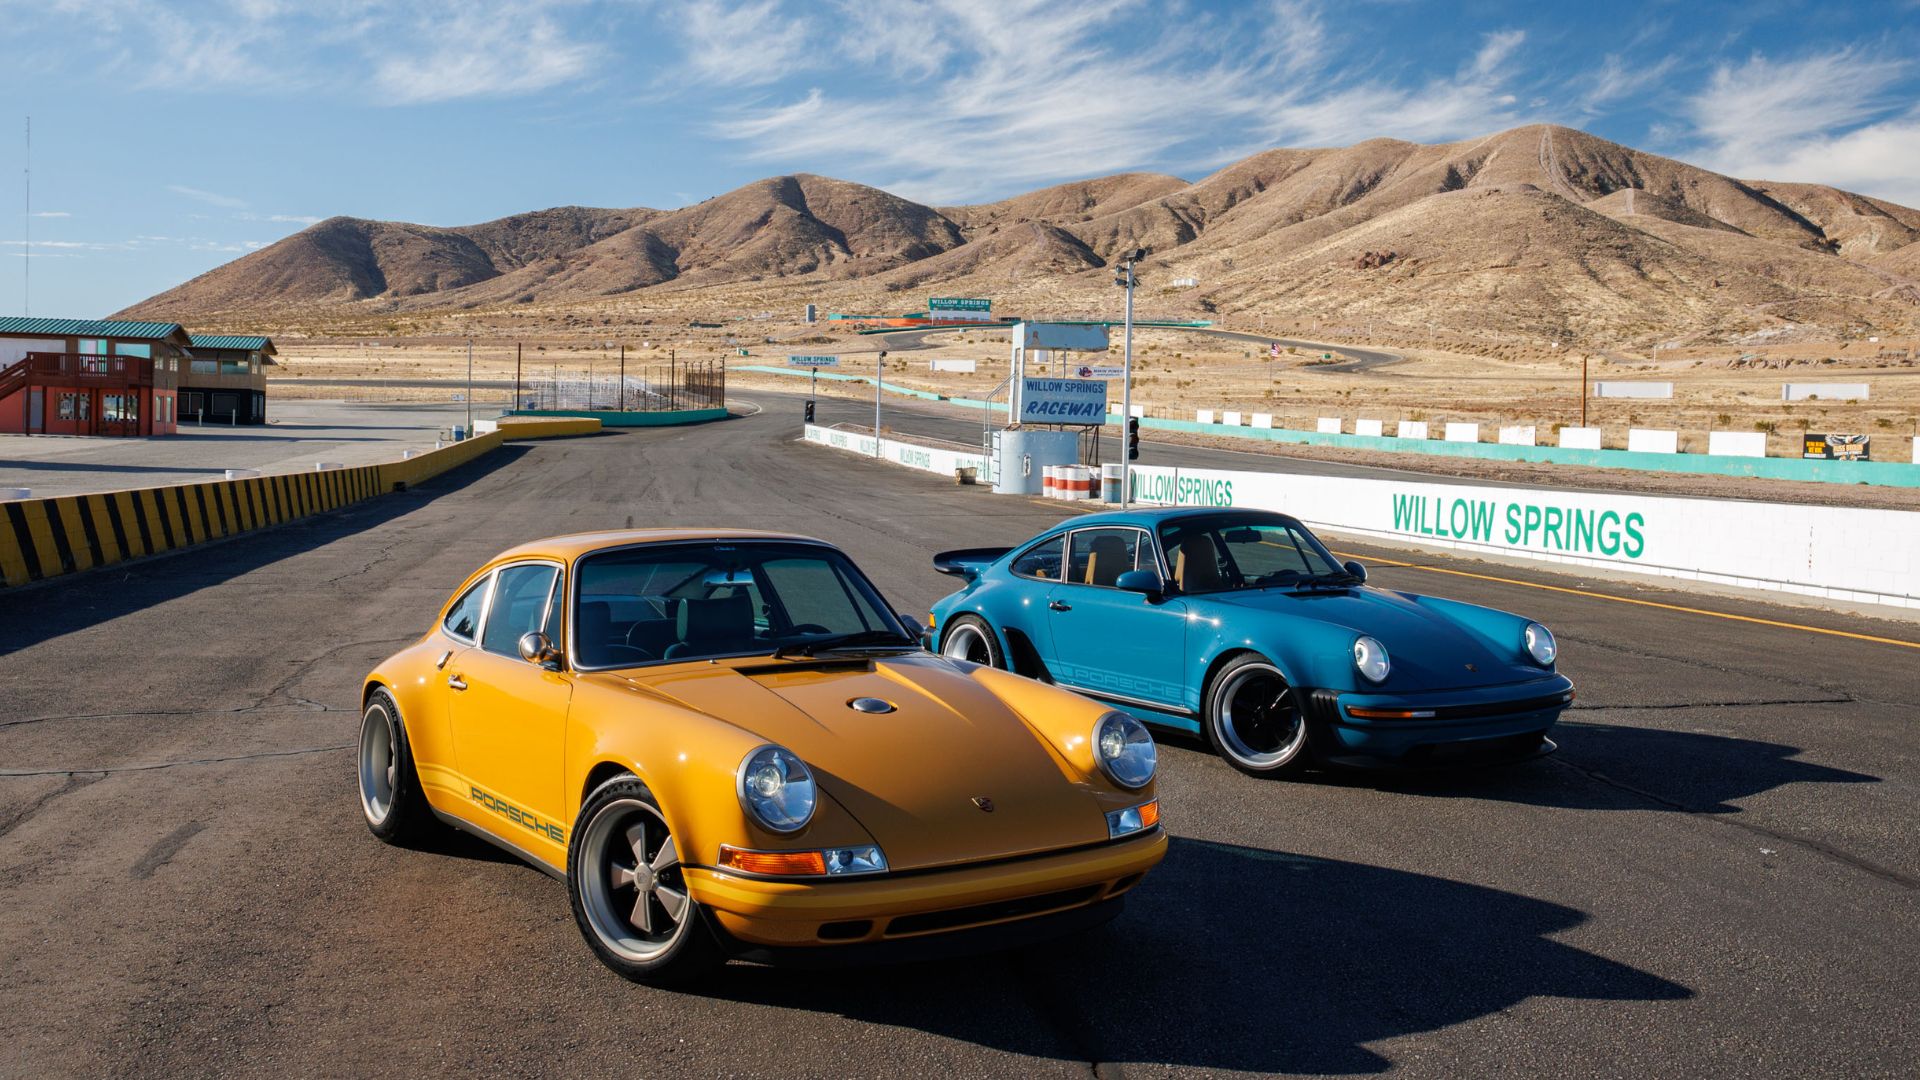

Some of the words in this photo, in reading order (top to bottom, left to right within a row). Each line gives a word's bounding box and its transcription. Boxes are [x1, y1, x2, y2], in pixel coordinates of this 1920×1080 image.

[1026, 381, 1063, 392] WILLOW
[1064, 382, 1104, 394] SPRINGS
[1025, 401, 1104, 417] RACEWAY
[1178, 476, 1233, 507] SPRINGS
[1393, 493, 1496, 542] WILLOW
[1505, 502, 1645, 559] SPRINGS
[1075, 669, 1182, 699] PORSCHE
[471, 786, 565, 844] PORSCHE
